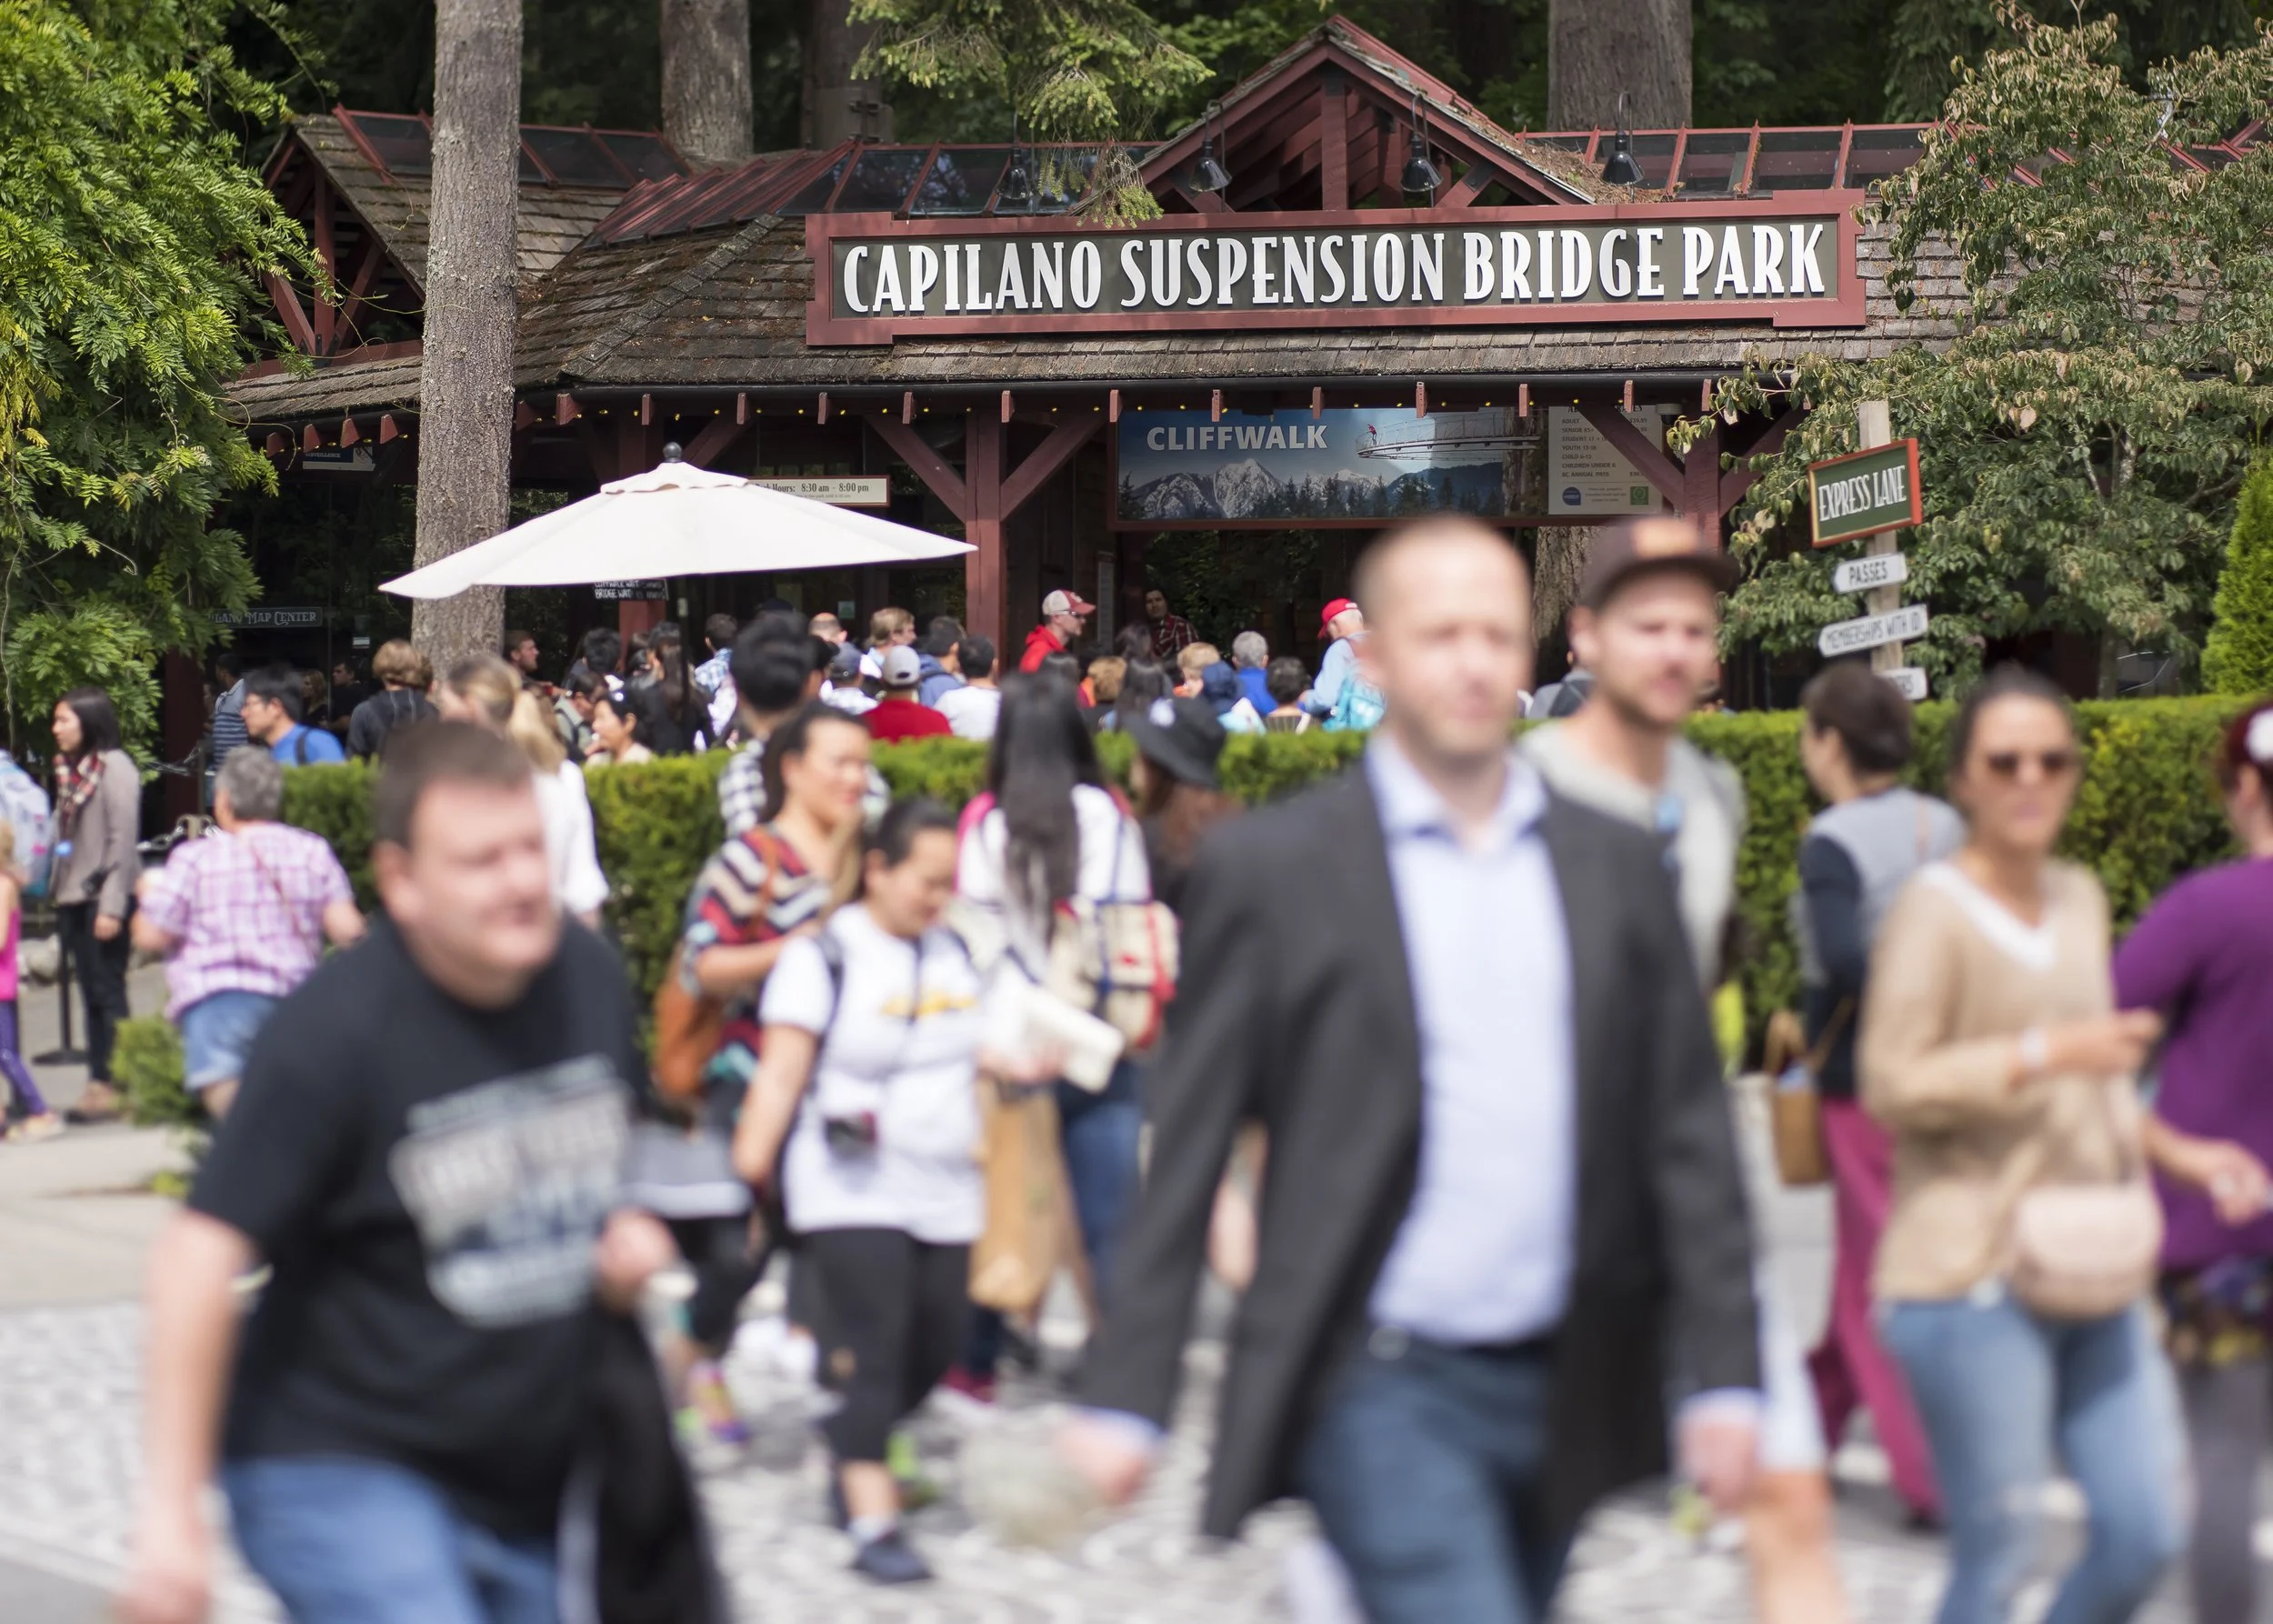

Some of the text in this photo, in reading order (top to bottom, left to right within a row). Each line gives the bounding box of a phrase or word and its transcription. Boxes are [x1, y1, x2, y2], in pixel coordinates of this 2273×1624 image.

[844, 224, 1825, 313] CAPILANO SUSPENSION BRIDGE PARK
[1147, 425, 1328, 451] CLIFFWALK
[772, 483, 796, 493] Hours:
[801, 482, 817, 492] 8:30
[839, 482, 856, 492] 8:00
[857, 485, 869, 494] pm
[1818, 465, 1907, 522] EXPRESS LANE
[1849, 560, 1887, 586] PASSES
[595, 588, 617, 599] BRIDGE
[617, 588, 632, 598] WAIT
[245, 611, 271, 625] MAP
[274, 611, 316, 625] CENTER
[1827, 620, 1883, 648] MEMBERSHIPS
[1886, 615, 1908, 637] WITH
